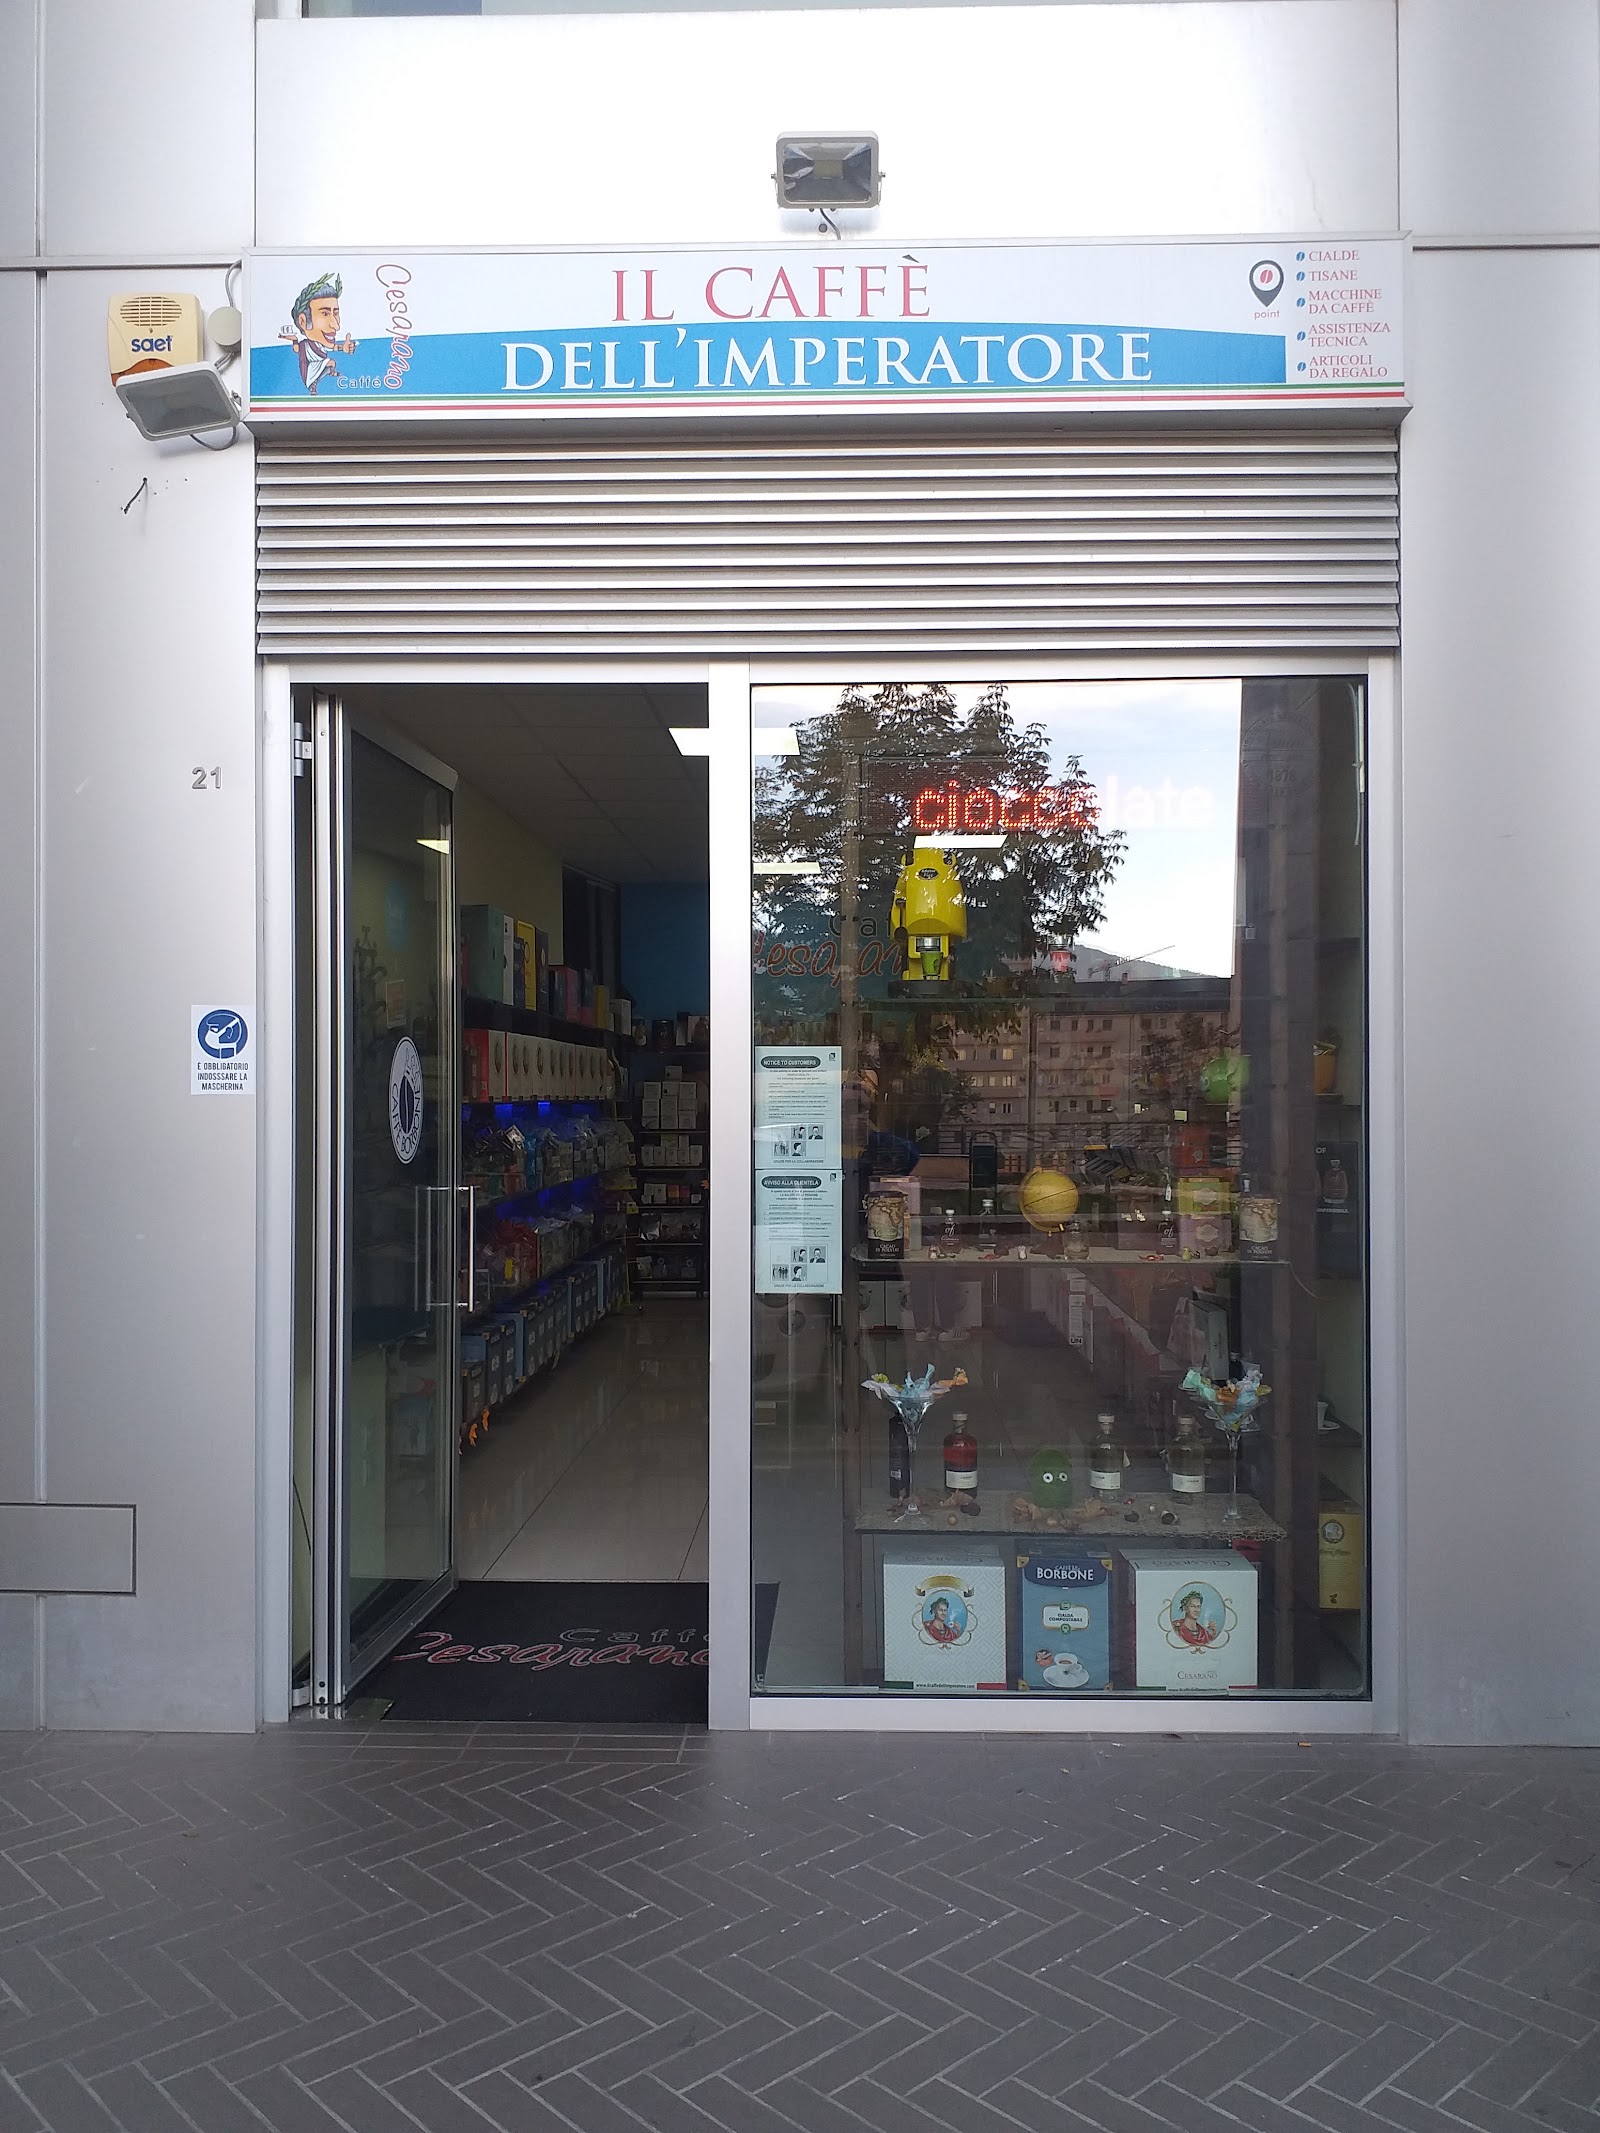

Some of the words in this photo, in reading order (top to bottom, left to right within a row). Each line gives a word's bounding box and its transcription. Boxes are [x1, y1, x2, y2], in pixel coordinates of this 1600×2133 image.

[1309, 250, 1360, 261] CIALDE
[1309, 270, 1358, 281] TISANE
[611, 269, 675, 321] IL
[705, 254, 930, 319] CAFFÈ
[1308, 289, 1382, 301] MACCHINE
[1309, 303, 1328, 314] DA
[1331, 300, 1374, 314] CAFFÈ
[1253, 309, 1280, 320] point
[375, 264, 414, 389] Cesarano
[1308, 322, 1391, 334] ASSISTENZA
[131, 335, 172, 352] saet
[1309, 336, 1368, 347] TECNICA
[501, 327, 1153, 391] DELL'IMPERATORE
[1309, 355, 1372, 366] ARTICOLI
[1309, 368, 1329, 379] DA
[1332, 366, 1388, 378] REGALO
[191, 766, 223, 789] 21
[203, 1062, 249, 1071] OBBLIGATORIO
[239, 1072, 248, 1081] LA
[201, 1082, 244, 1091] MASCHERINA
[1036, 1566, 1094, 1581] BORBONE
